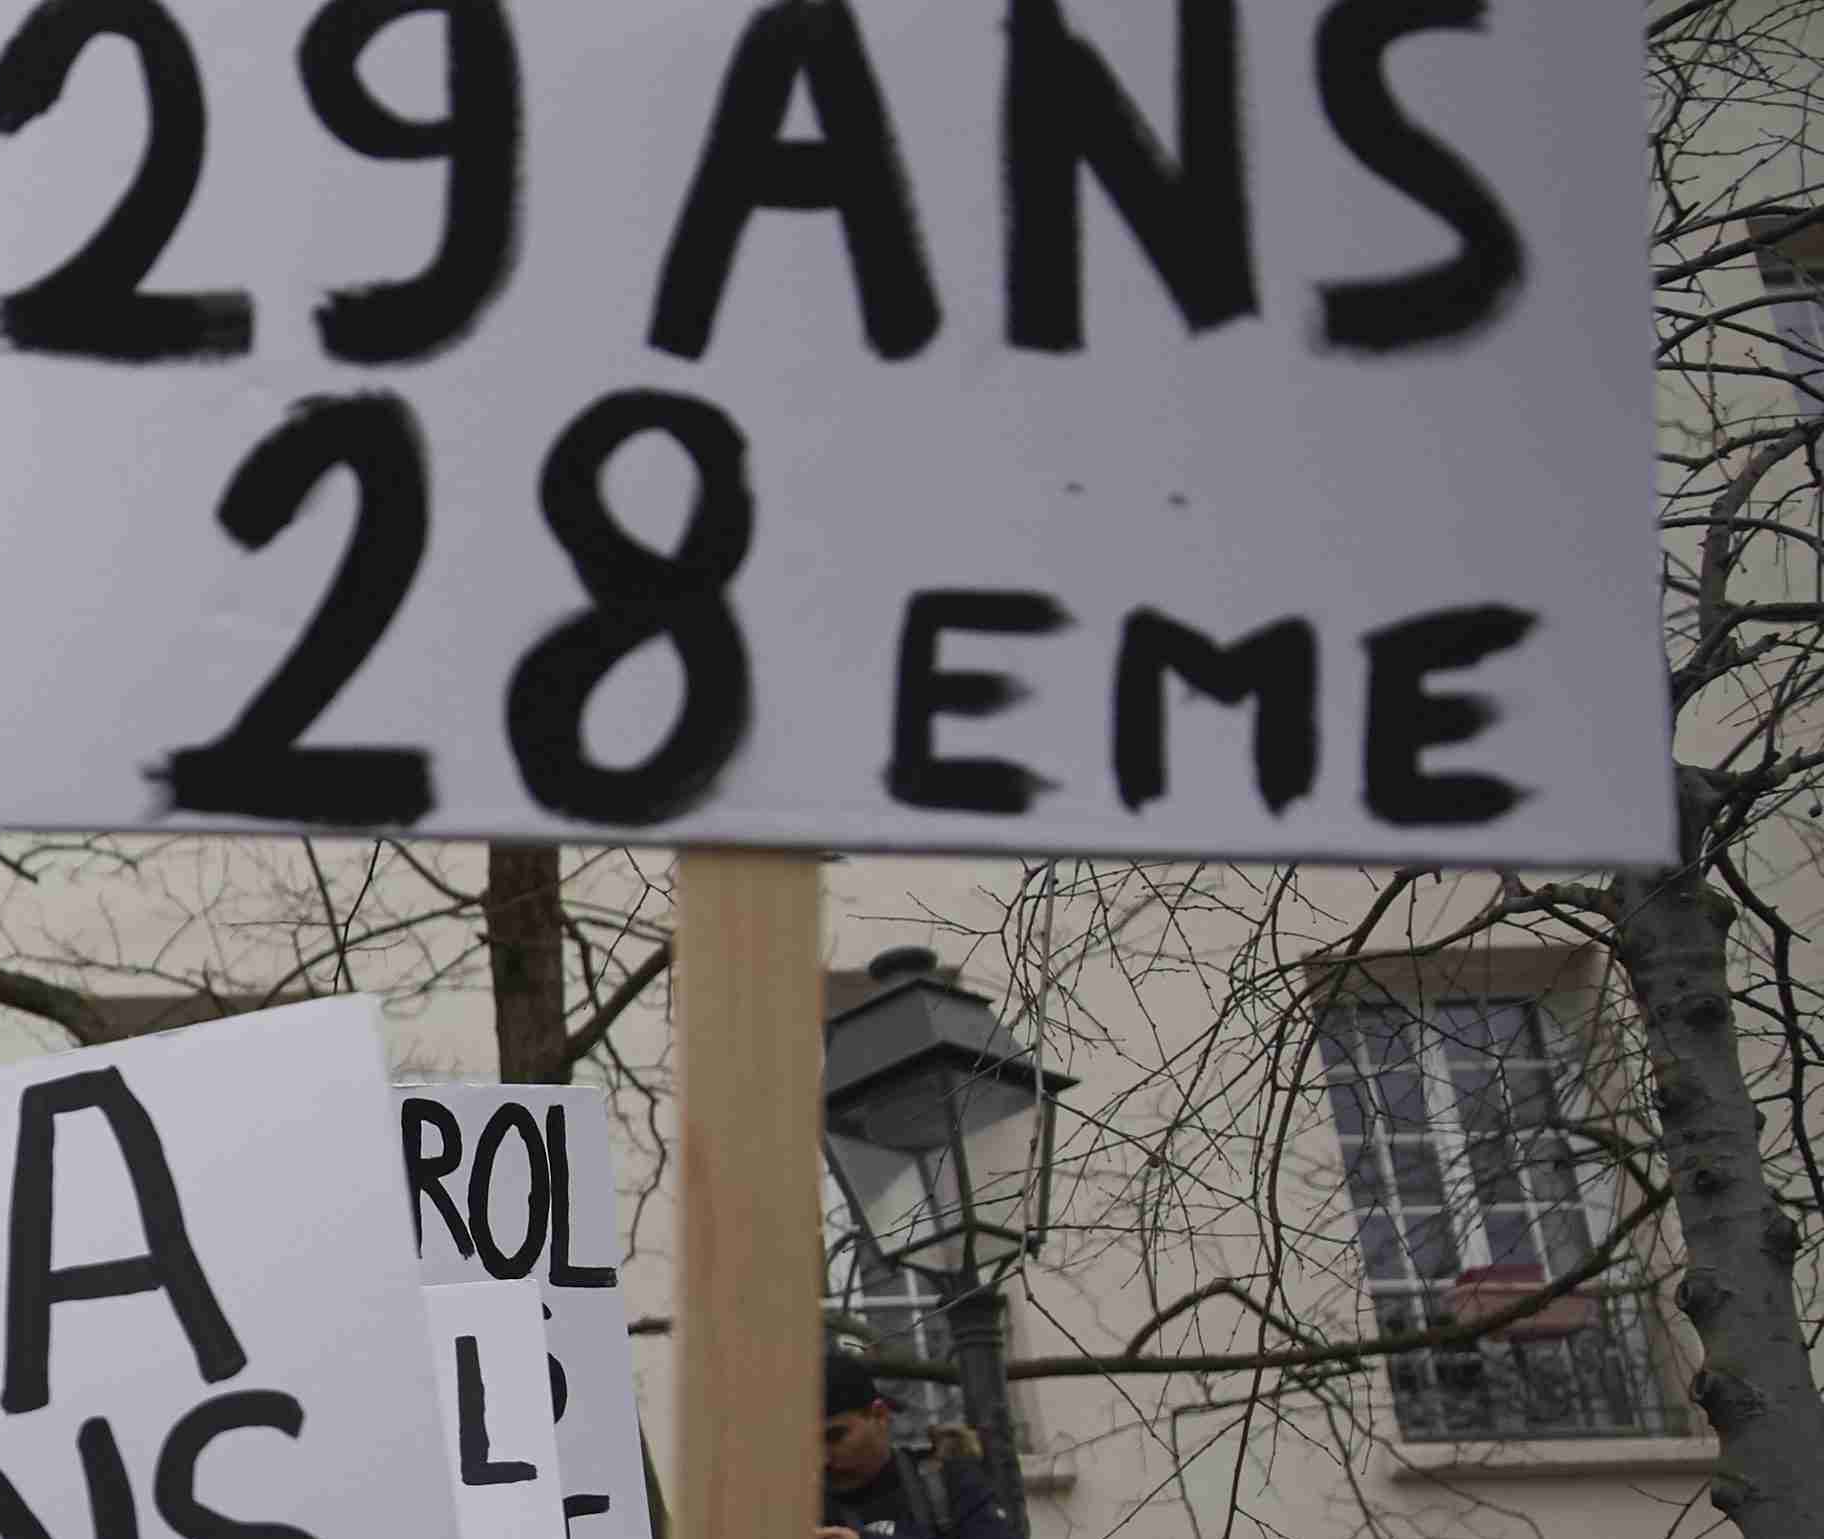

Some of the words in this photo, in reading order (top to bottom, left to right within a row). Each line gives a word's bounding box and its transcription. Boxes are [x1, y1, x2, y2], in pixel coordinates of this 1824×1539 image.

[645, 0, 1530, 362] ANS
[144, 386, 760, 828] 28
[880, 588, 1544, 822] EME
